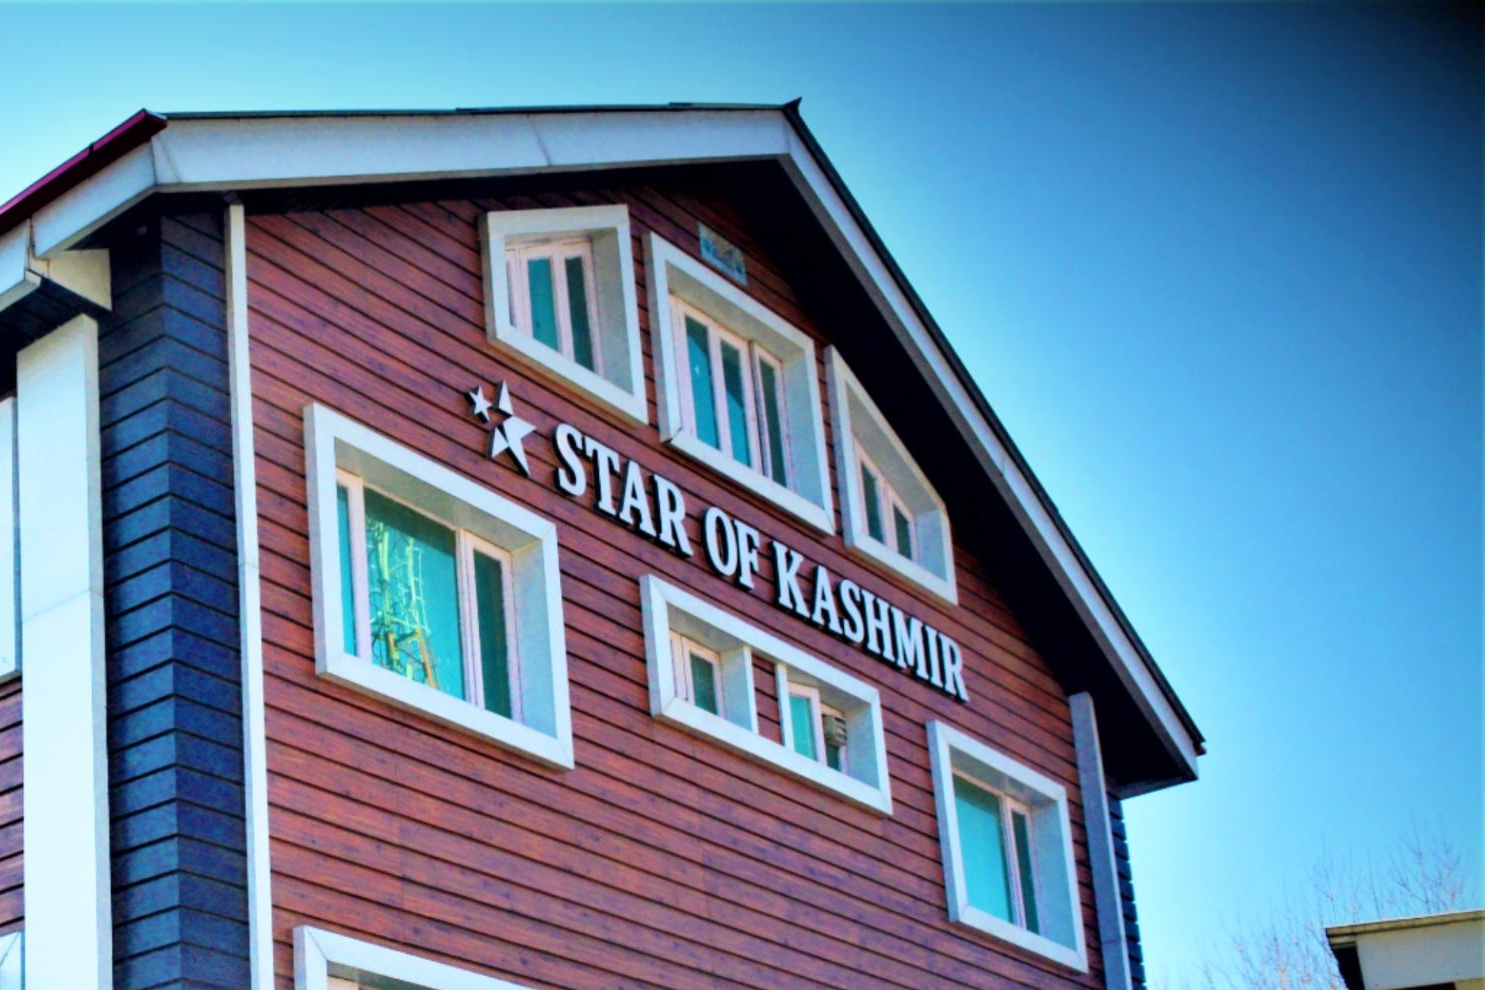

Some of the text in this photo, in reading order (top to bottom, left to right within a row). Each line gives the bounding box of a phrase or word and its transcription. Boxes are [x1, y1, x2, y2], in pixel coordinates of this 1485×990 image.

[555, 423, 970, 702] STAR OF KASHMIR
